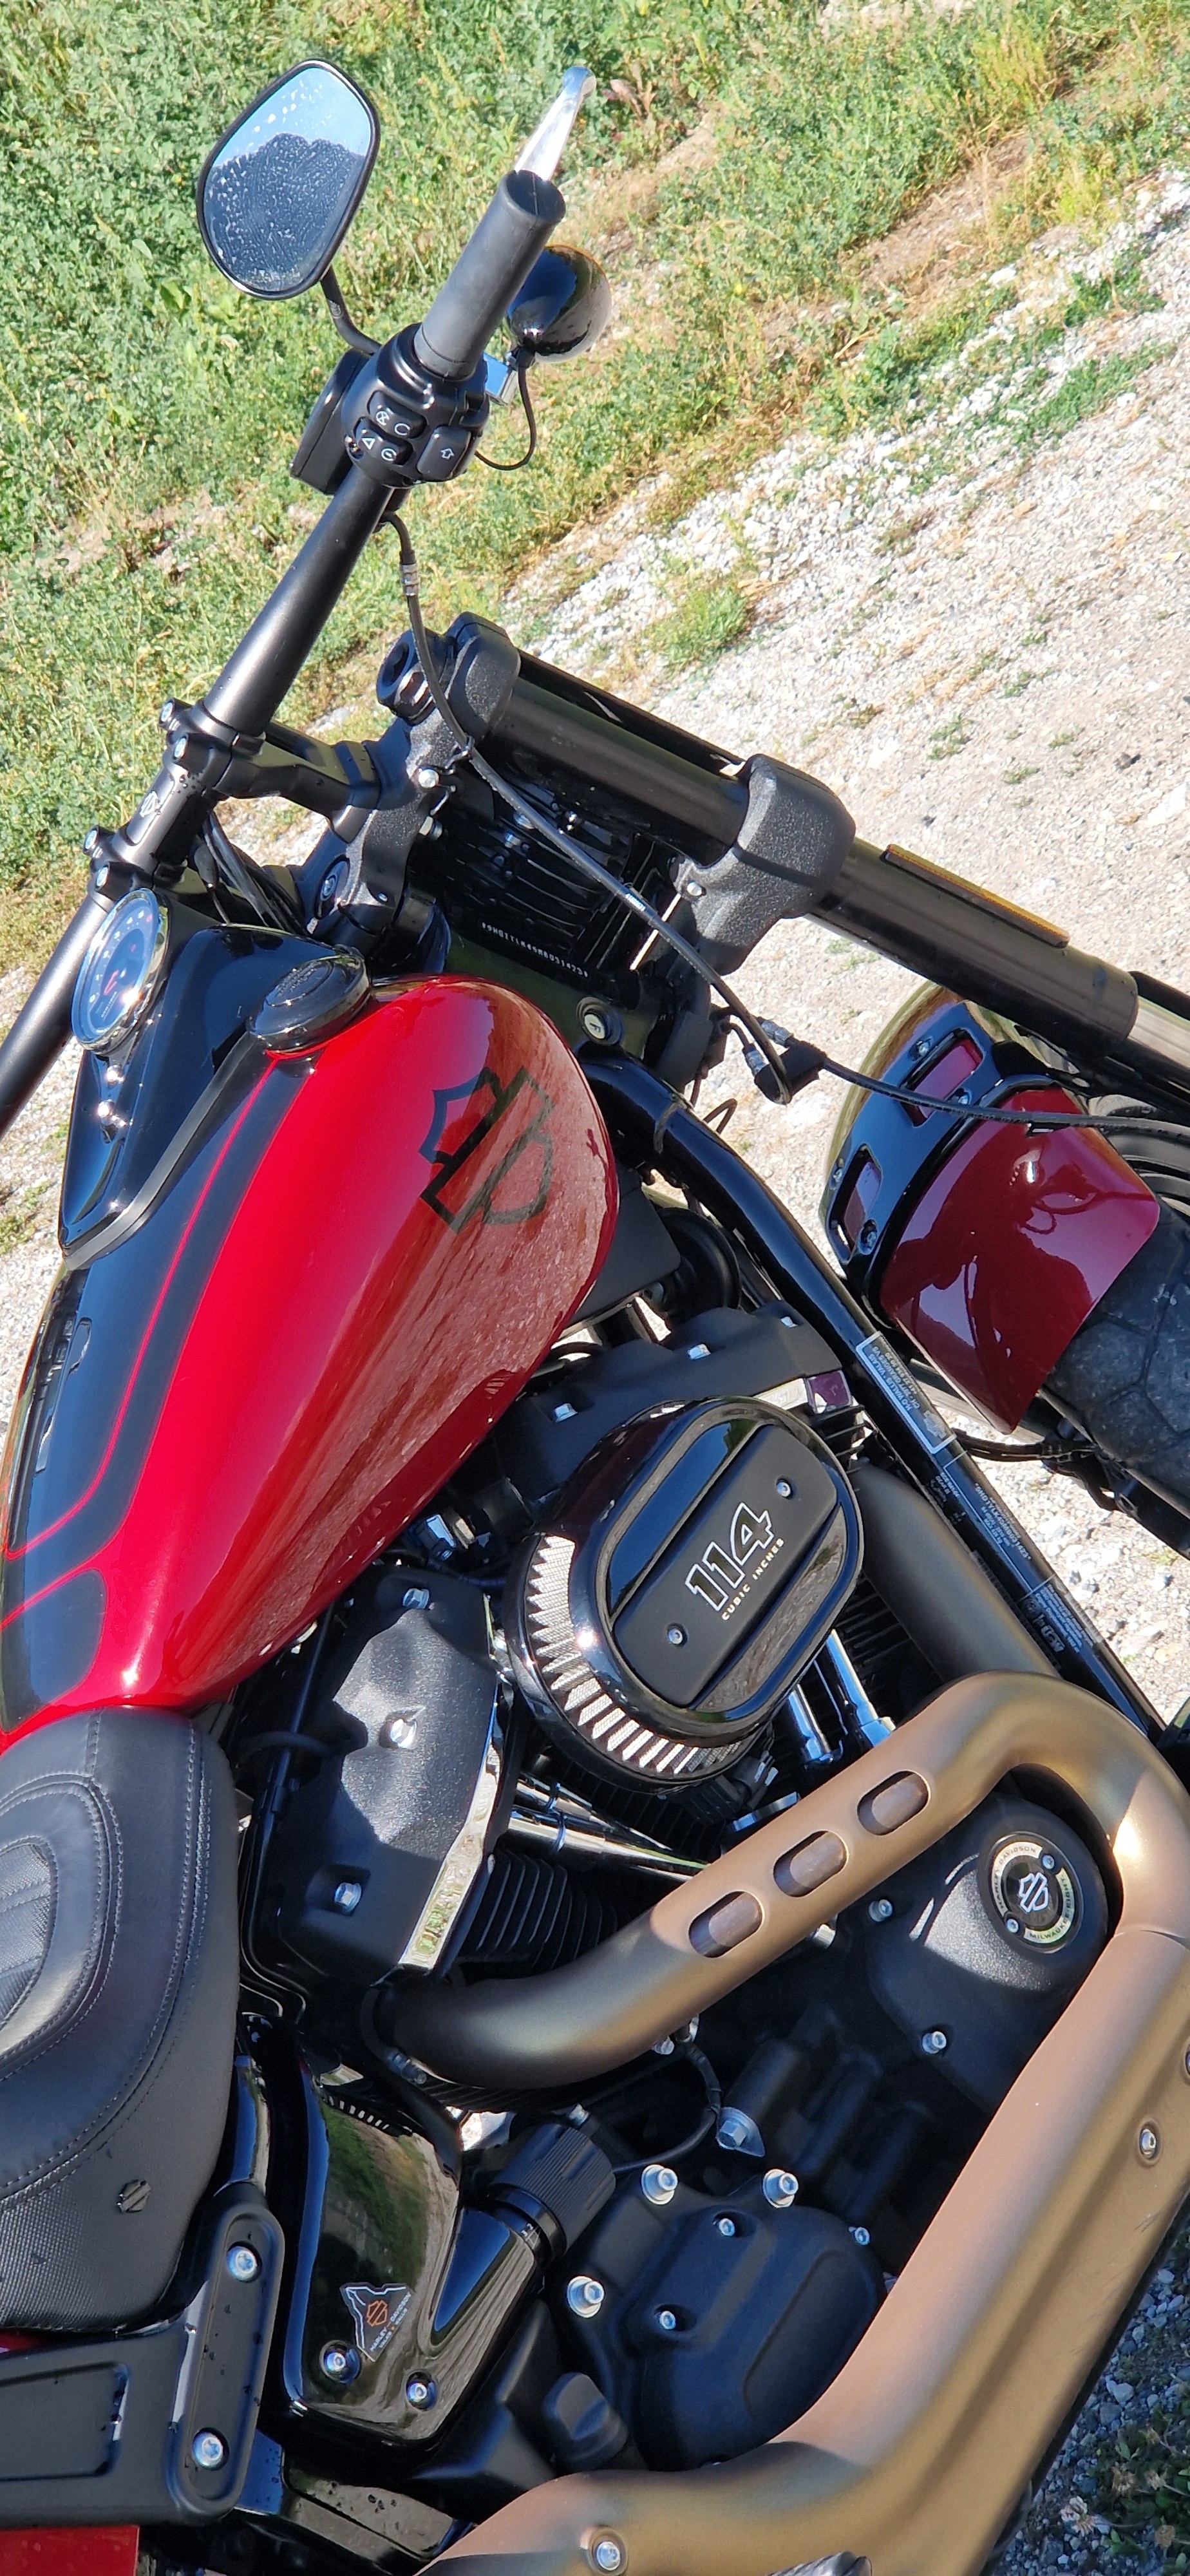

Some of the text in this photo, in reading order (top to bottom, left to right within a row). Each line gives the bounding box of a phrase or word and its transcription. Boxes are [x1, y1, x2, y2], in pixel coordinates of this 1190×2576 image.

[867, 1352, 887, 1375] VALAIS
[910, 1398, 920, 1409] CH
[685, 1502, 774, 1611] 114
[721, 1537, 785, 1621] CUBIC INCHES
